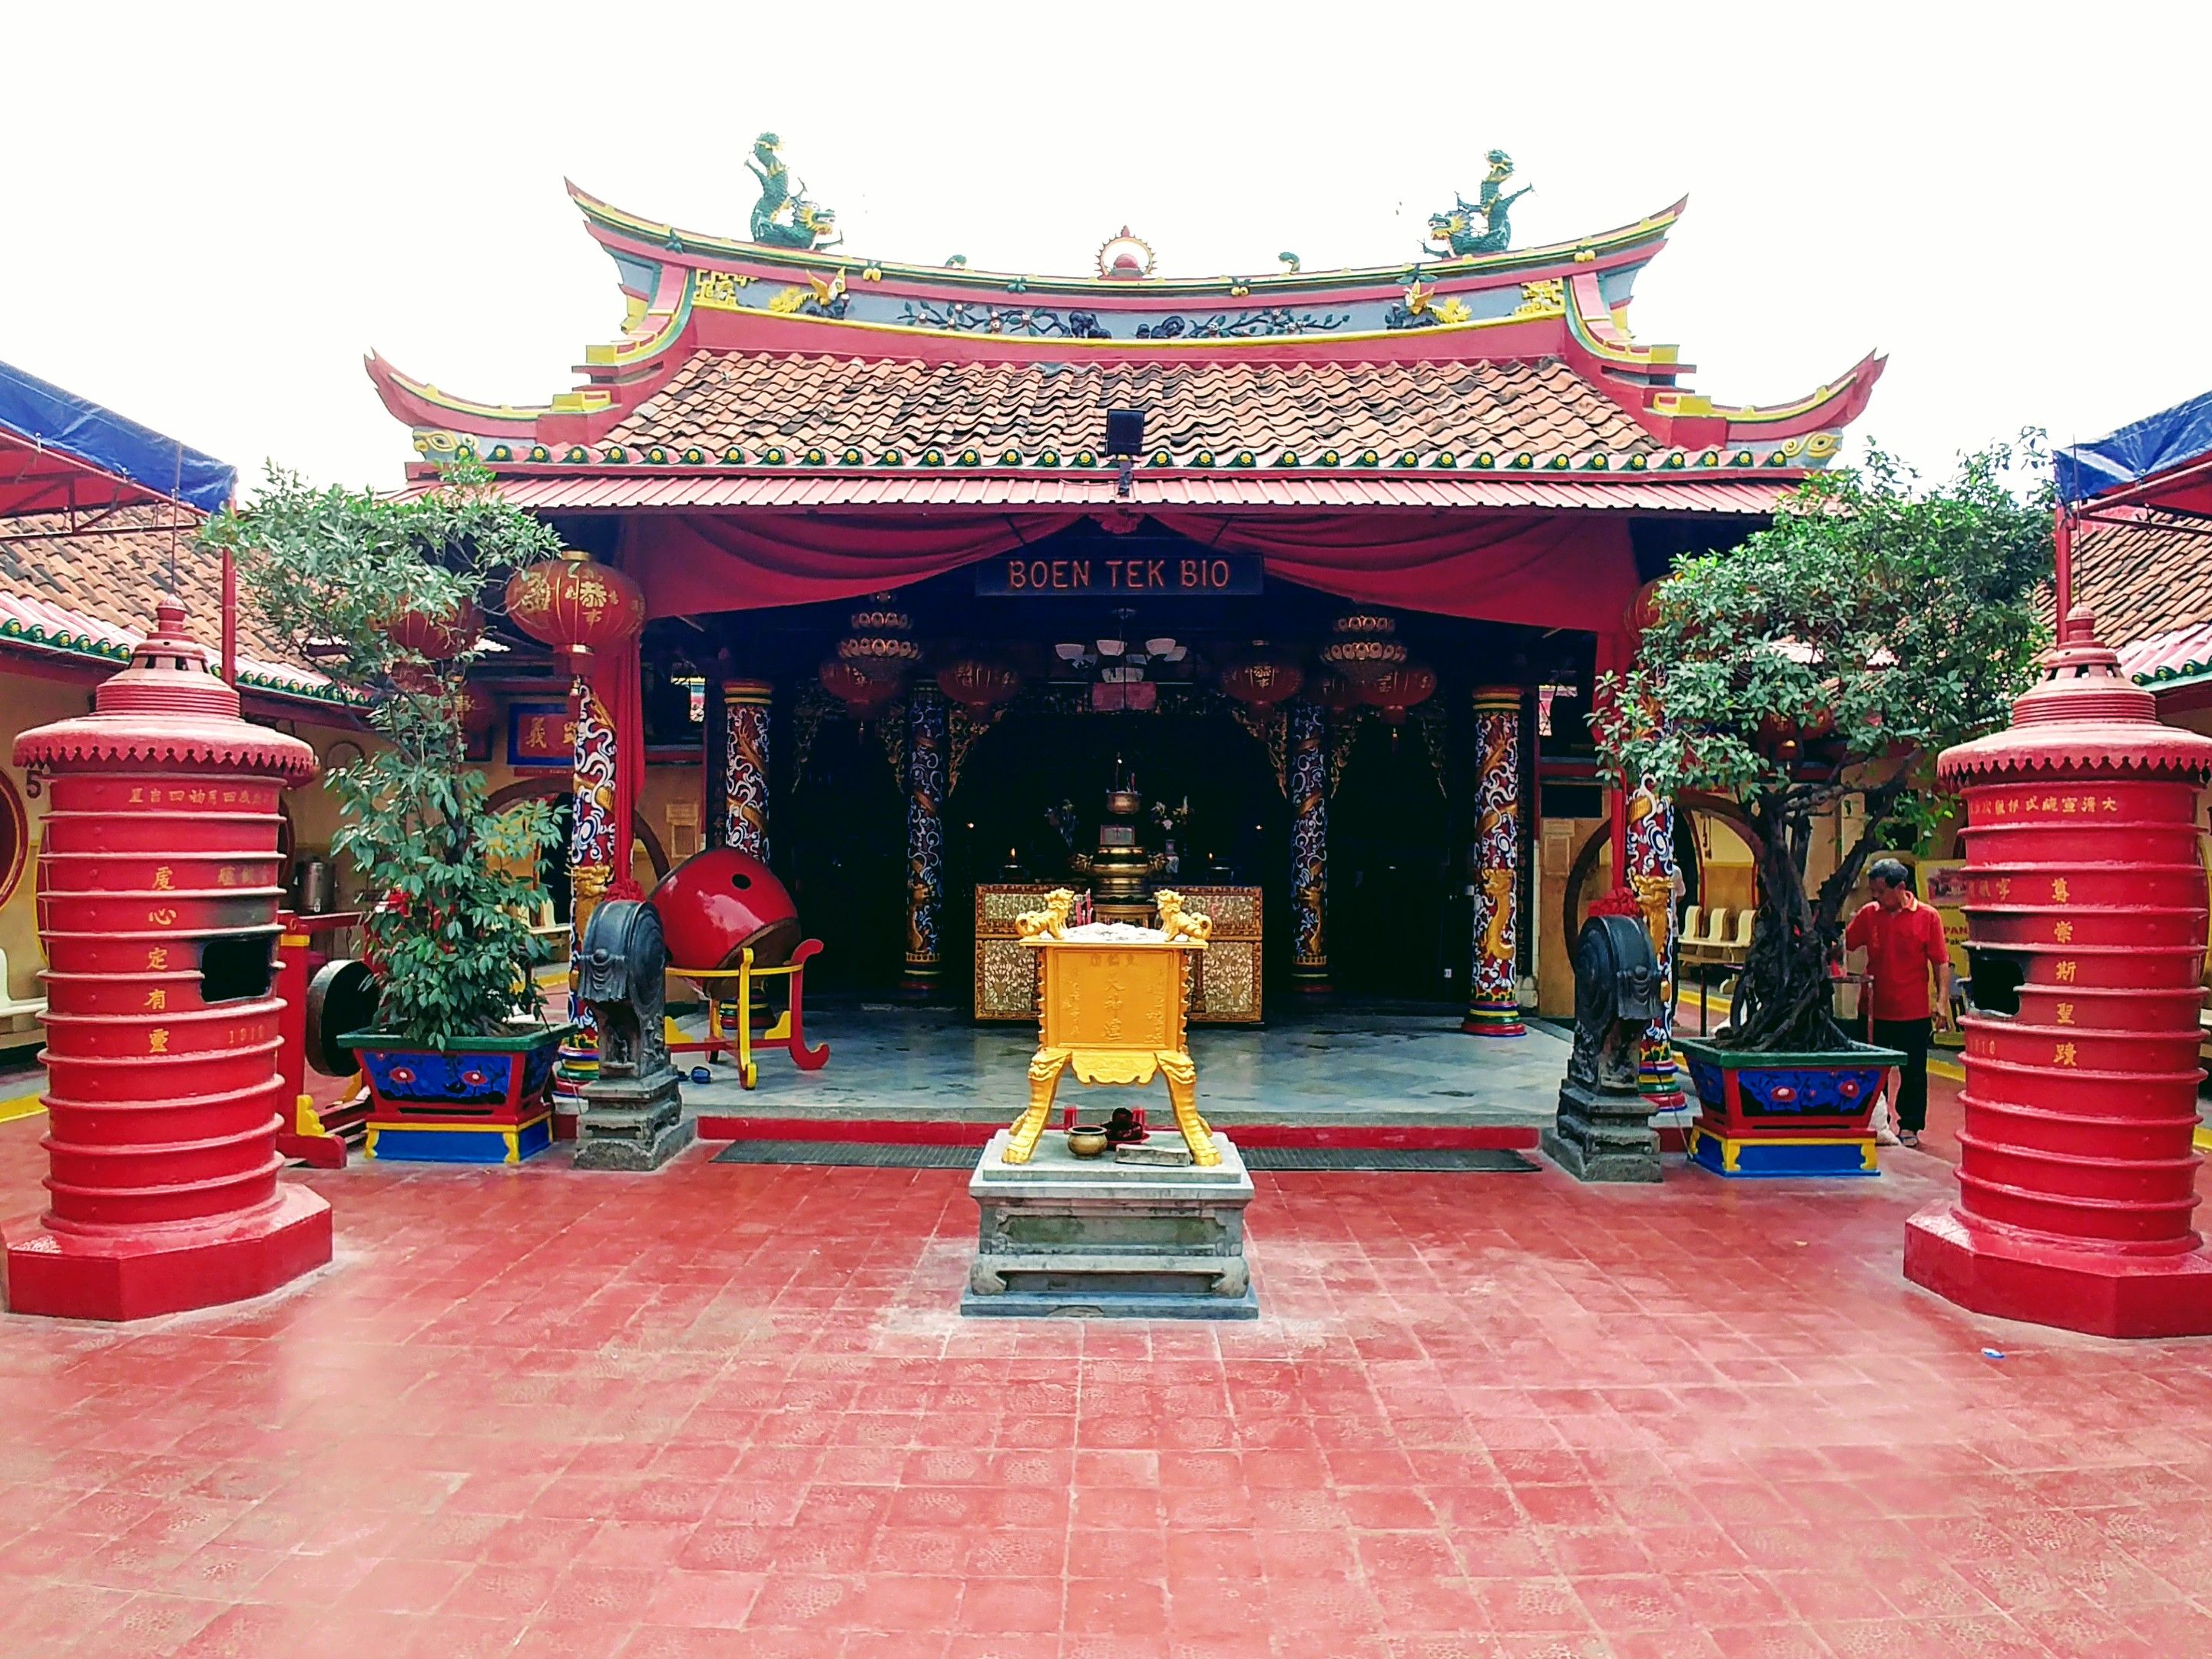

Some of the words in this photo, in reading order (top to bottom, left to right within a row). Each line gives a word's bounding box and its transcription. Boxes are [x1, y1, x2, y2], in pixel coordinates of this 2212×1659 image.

[1008, 560, 1090, 589] BOEN
[1105, 559, 1165, 588] TEK
[1181, 559, 1231, 588] BIO
